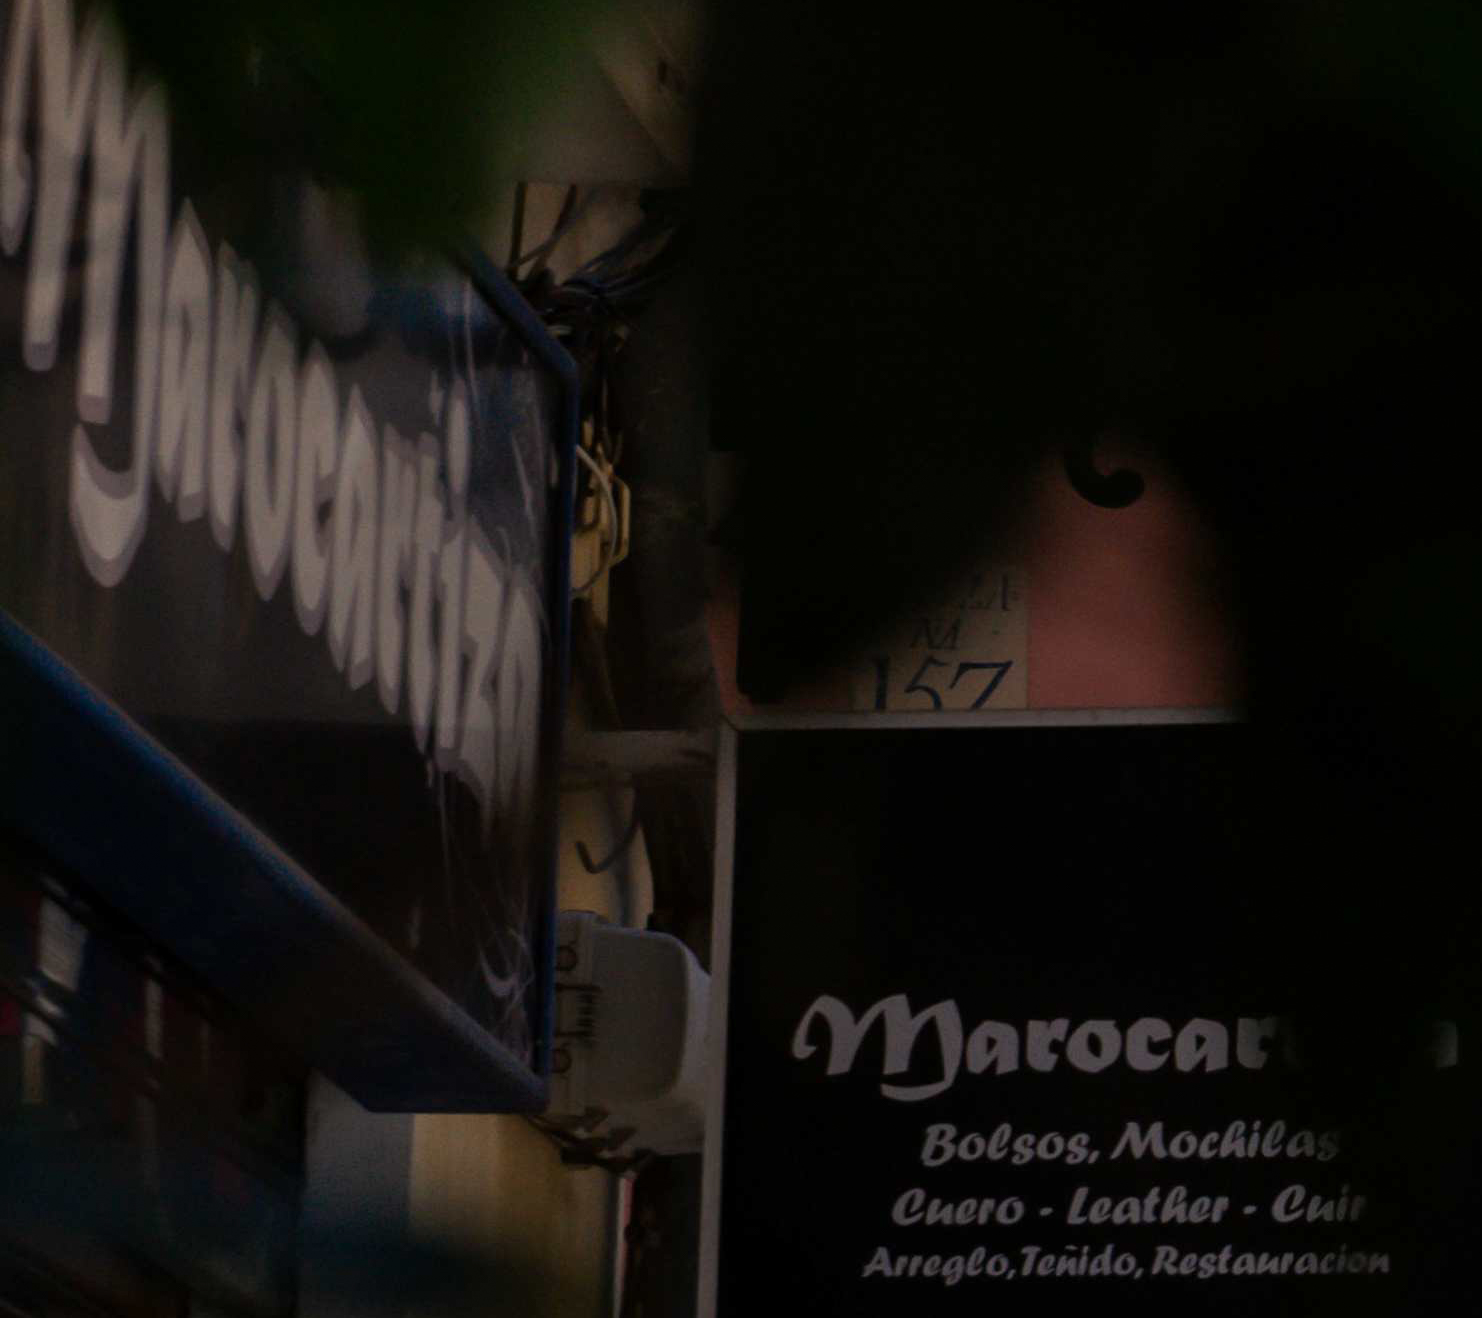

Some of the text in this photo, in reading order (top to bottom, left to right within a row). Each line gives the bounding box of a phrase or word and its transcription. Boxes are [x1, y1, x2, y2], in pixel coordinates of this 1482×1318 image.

[791, 992, 1460, 1103] Marocar
[919, 1118, 1340, 1168] Bolsos, Mochilas
[890, 1186, 1026, 1226] Cuero
[1065, 1184, 1230, 1225] Leather
[1269, 1183, 1367, 1223] Cuir
